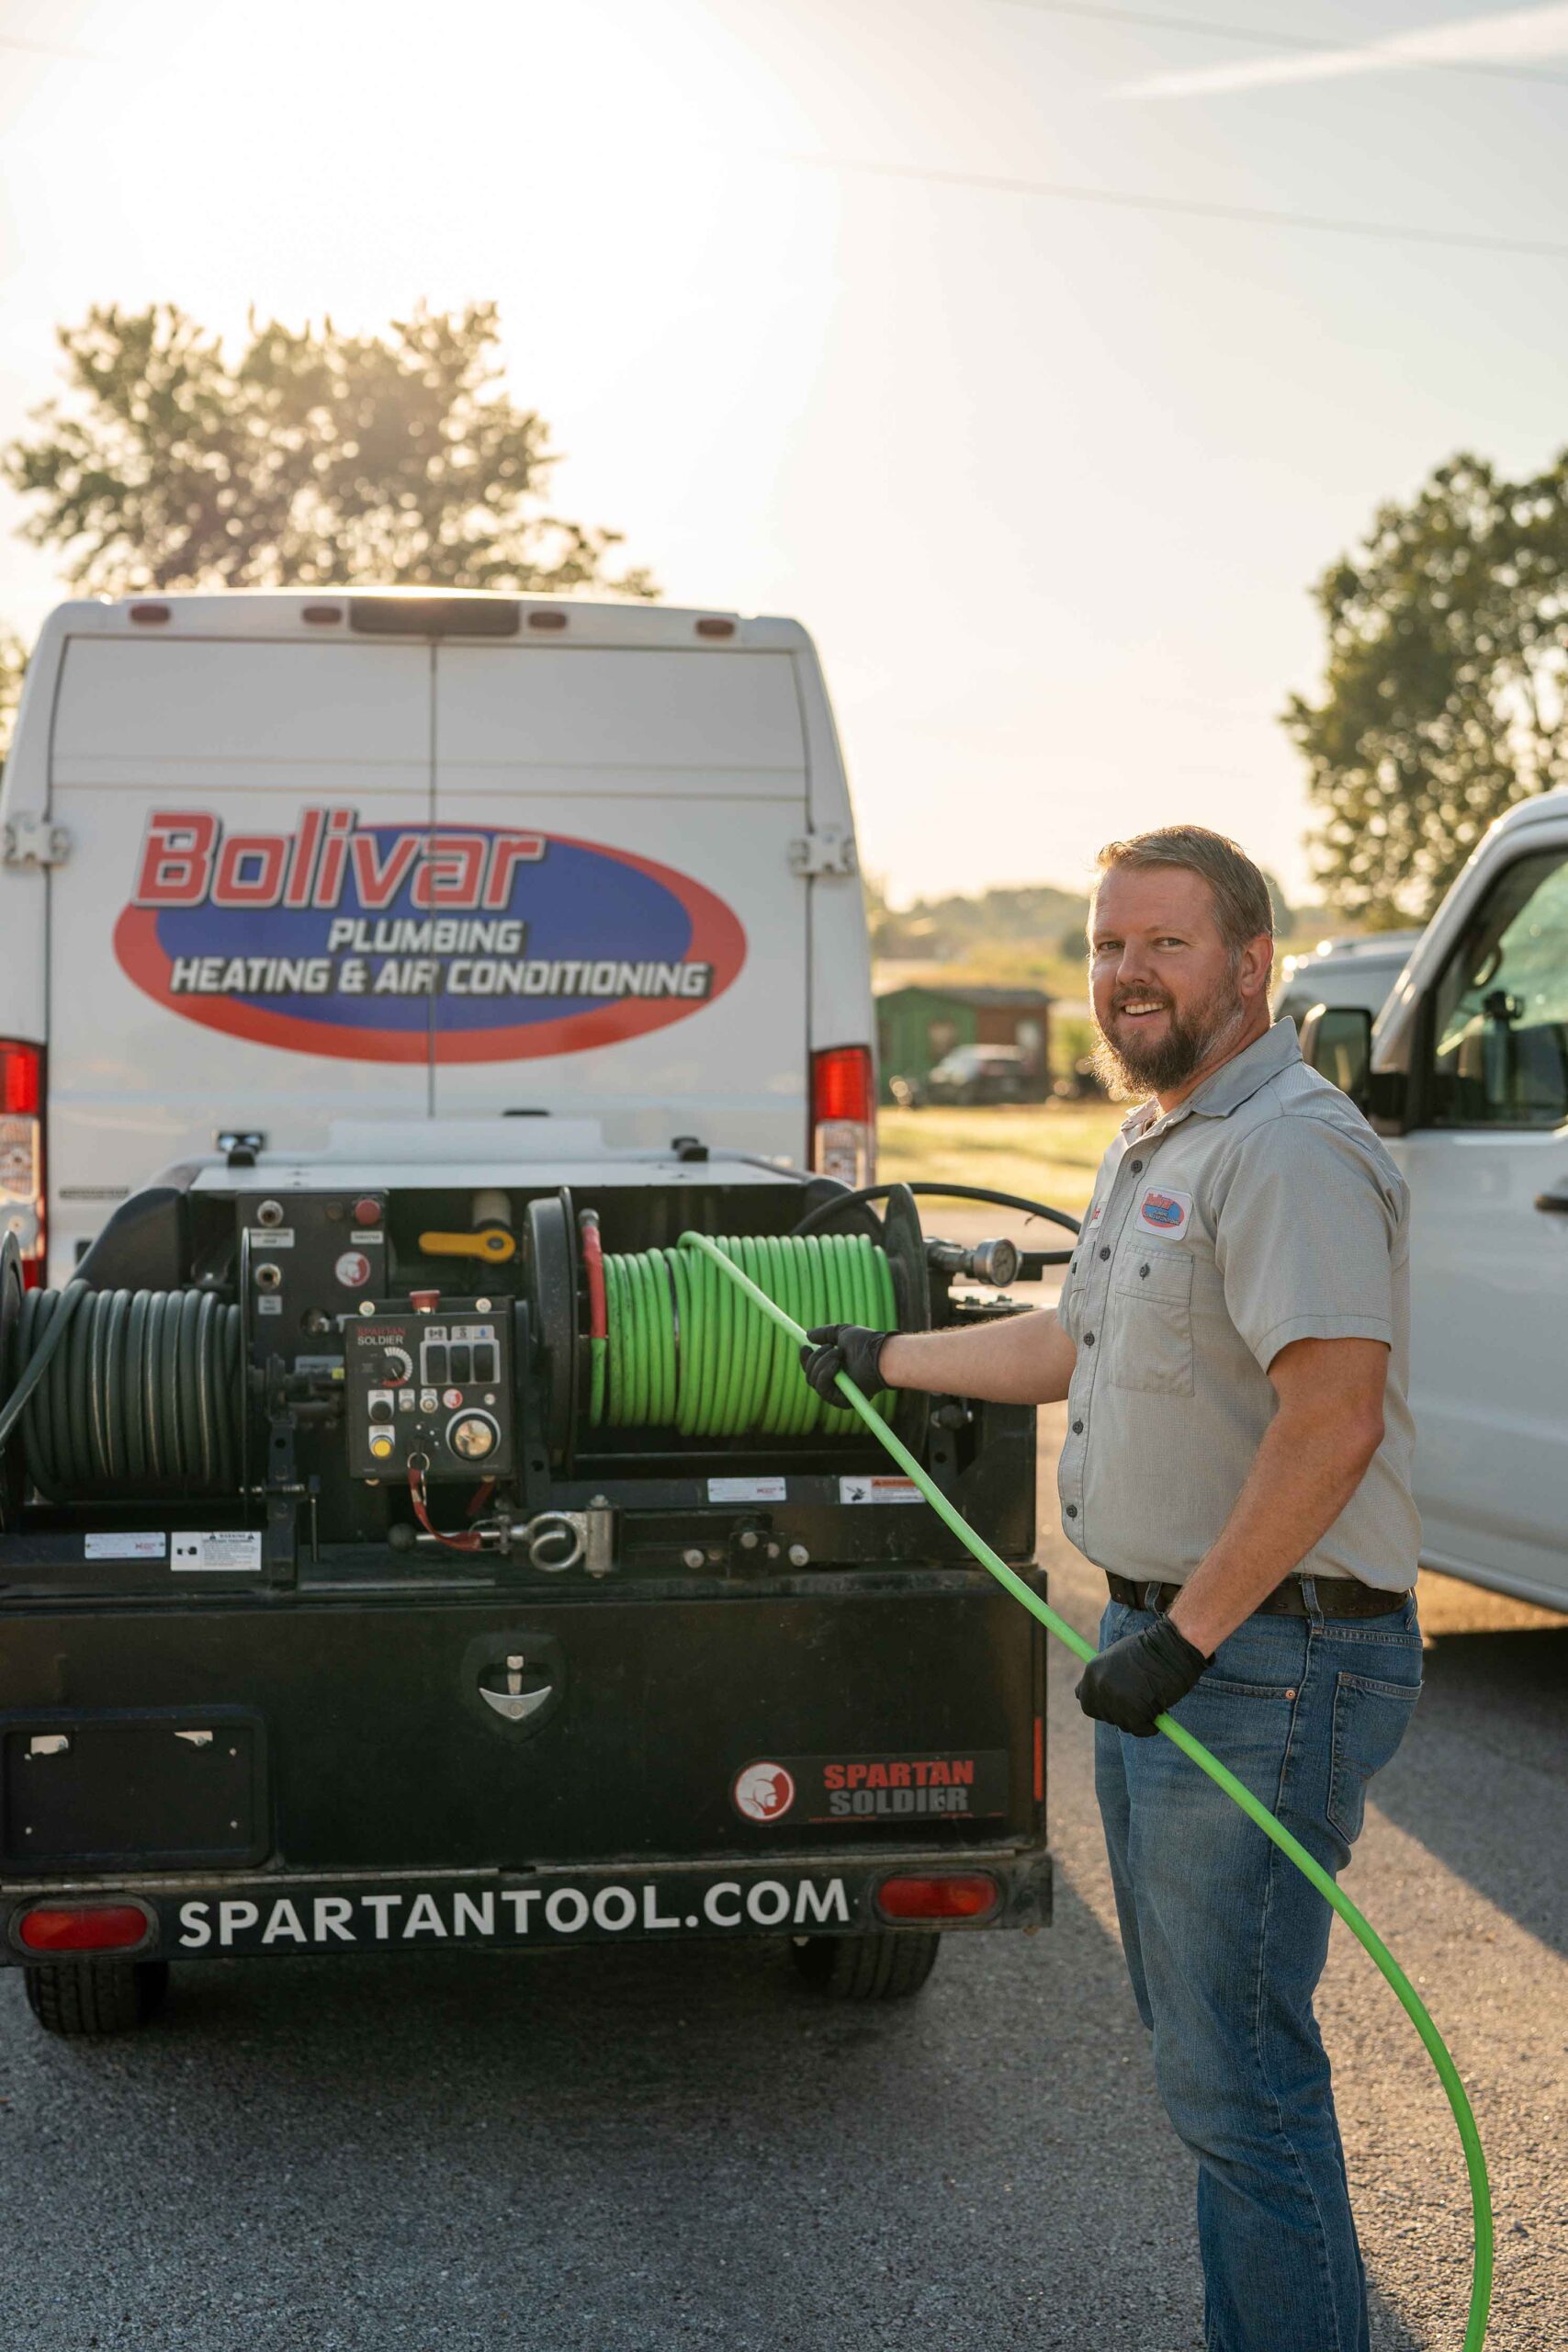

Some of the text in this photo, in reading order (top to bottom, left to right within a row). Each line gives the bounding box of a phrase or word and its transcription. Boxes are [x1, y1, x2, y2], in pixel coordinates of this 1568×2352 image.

[132, 807, 547, 908] Bolivar
[327, 919, 524, 955] PLUMBING
[171, 957, 709, 997] HEATING & AIR CONDITIONING
[356, 1326, 406, 1336] SPARTAN
[357, 1335, 404, 1346] SOLDIER
[823, 1760, 975, 1790] SPARTAN
[829, 1787, 969, 1815] SOLDIER
[178, 1879, 851, 1949] SPARTANTOOL.COM
